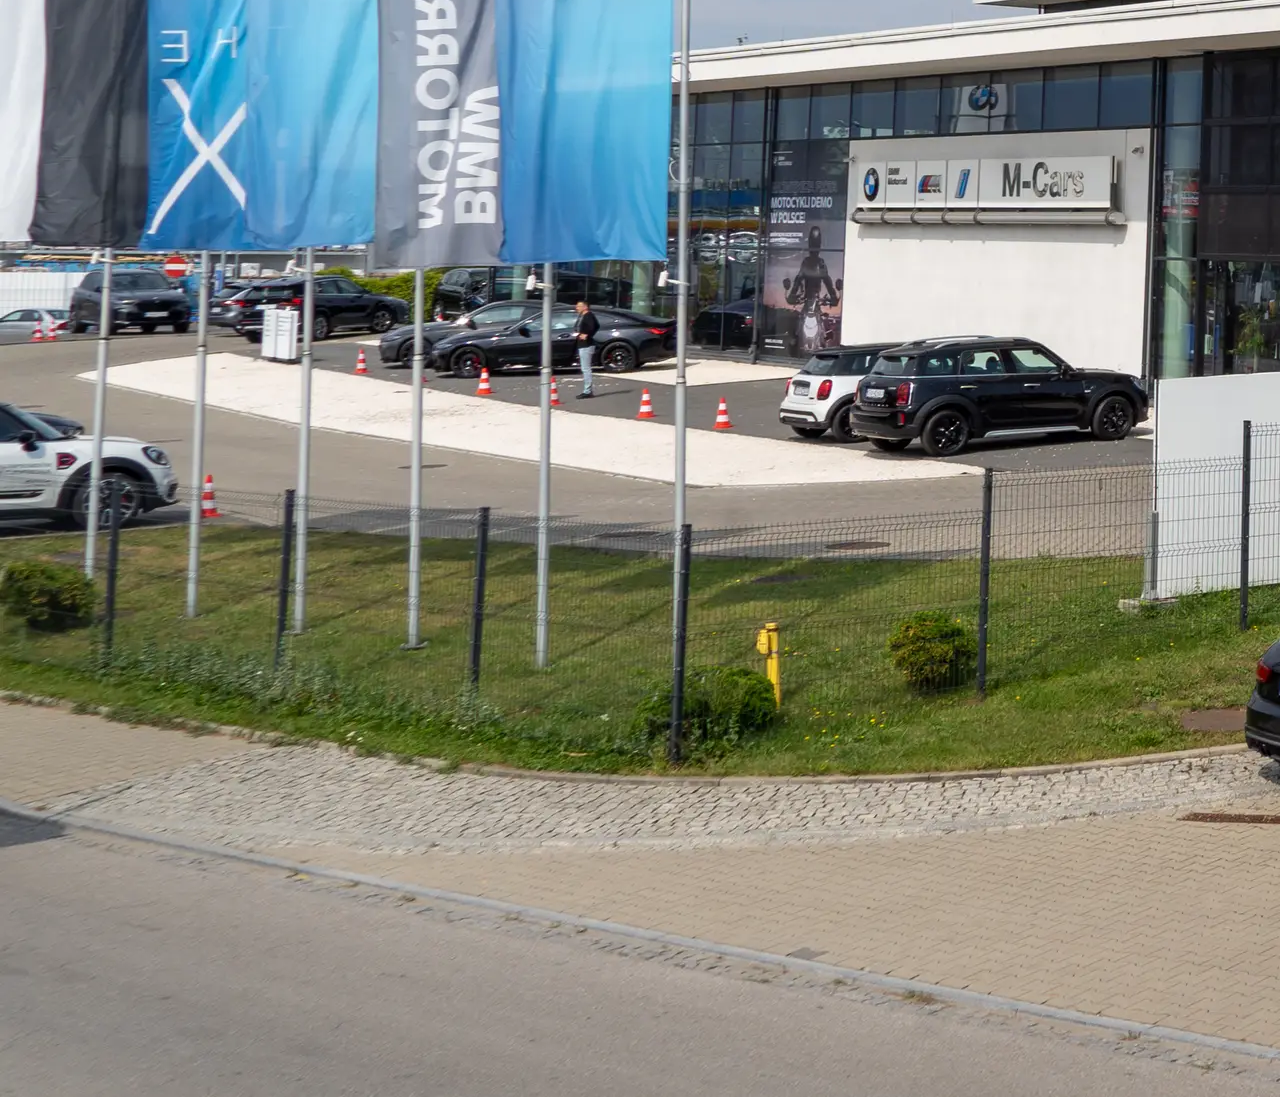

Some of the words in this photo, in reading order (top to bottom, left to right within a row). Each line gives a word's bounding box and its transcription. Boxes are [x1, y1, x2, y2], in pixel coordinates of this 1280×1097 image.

[888, 177, 908, 185] Motorrad
[1002, 162, 1085, 198] M-Cars
[771, 196, 810, 208] MOTOCYKLI
[811, 196, 833, 208] DEMO
[770, 212, 779, 224] W
[779, 211, 805, 224] POLSCE!
